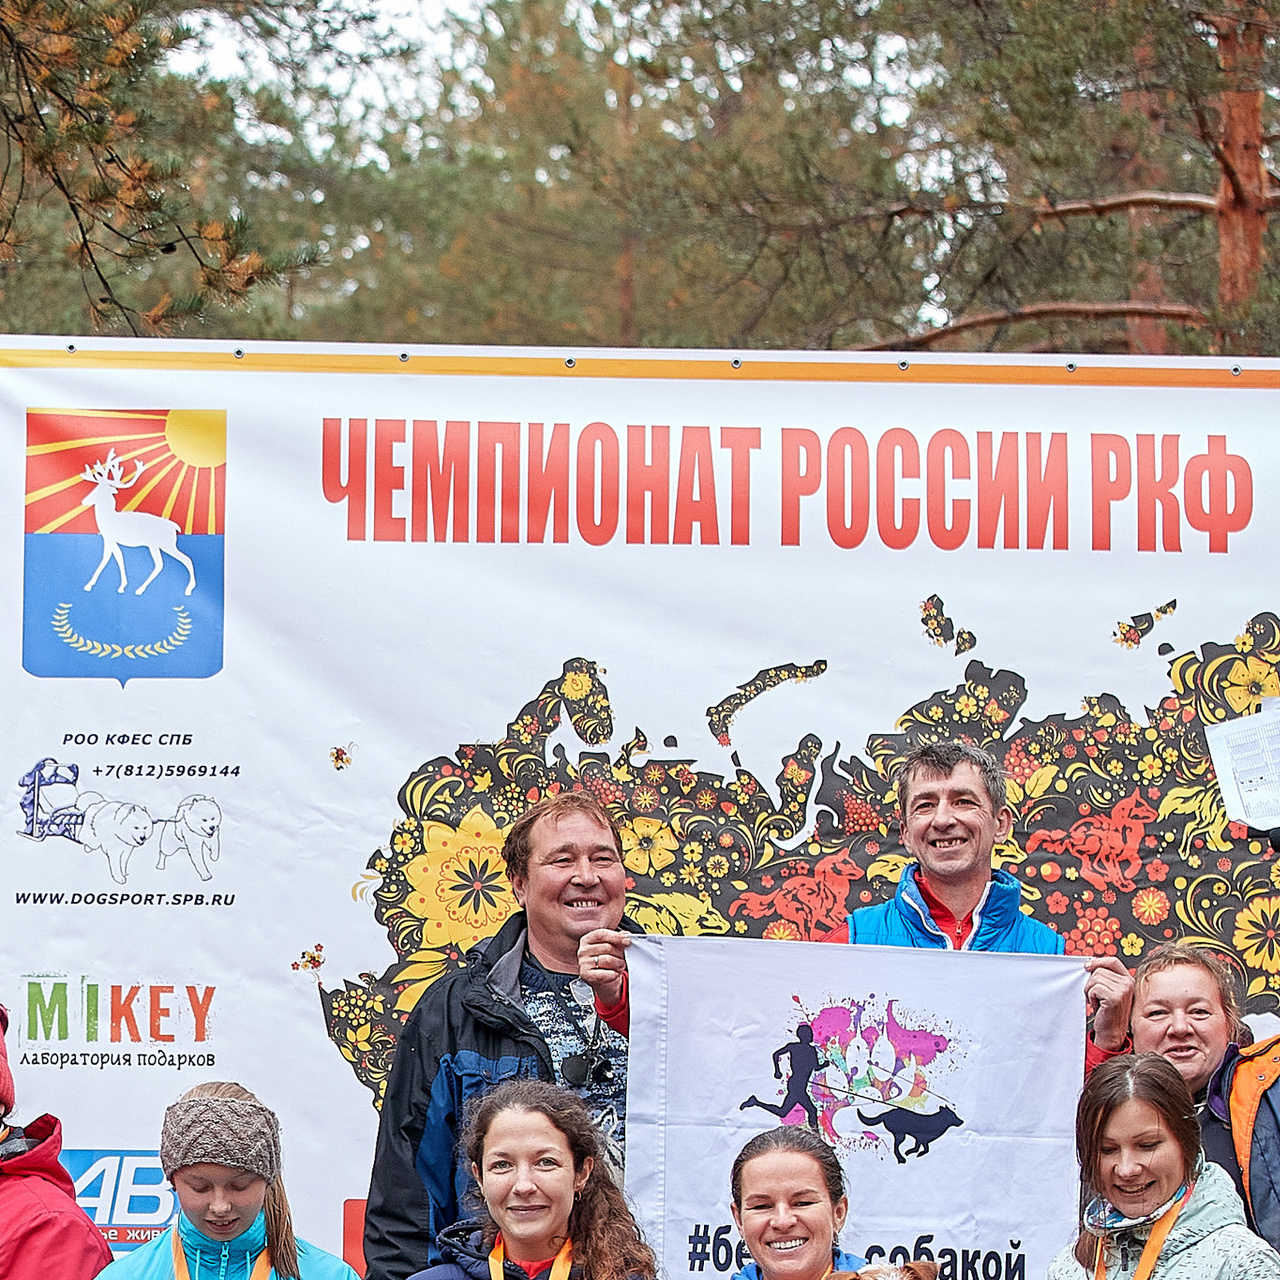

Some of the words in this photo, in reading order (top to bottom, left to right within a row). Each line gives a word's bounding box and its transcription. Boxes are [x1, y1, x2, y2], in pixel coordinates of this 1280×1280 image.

[322, 418, 761, 547] ЧЕМПИОНАТ
[781, 426, 1069, 551] РОССИИ
[1091, 433, 1253, 554] РКФ
[63, 734, 99, 746] РОО
[105, 734, 153, 746] КФЕС
[158, 734, 193, 746] СПБ
[92, 765, 241, 780] +7(812)5969144
[16, 893, 236, 906] WWW.DOGSPORT.SPB.RU
[27, 982, 216, 1043] MIKEY
[19, 1053, 132, 1070] лаборатория
[137, 1050, 216, 1071] подарков
[73, 1156, 177, 1225] АВ
[688, 1224, 752, 1272] #бе
